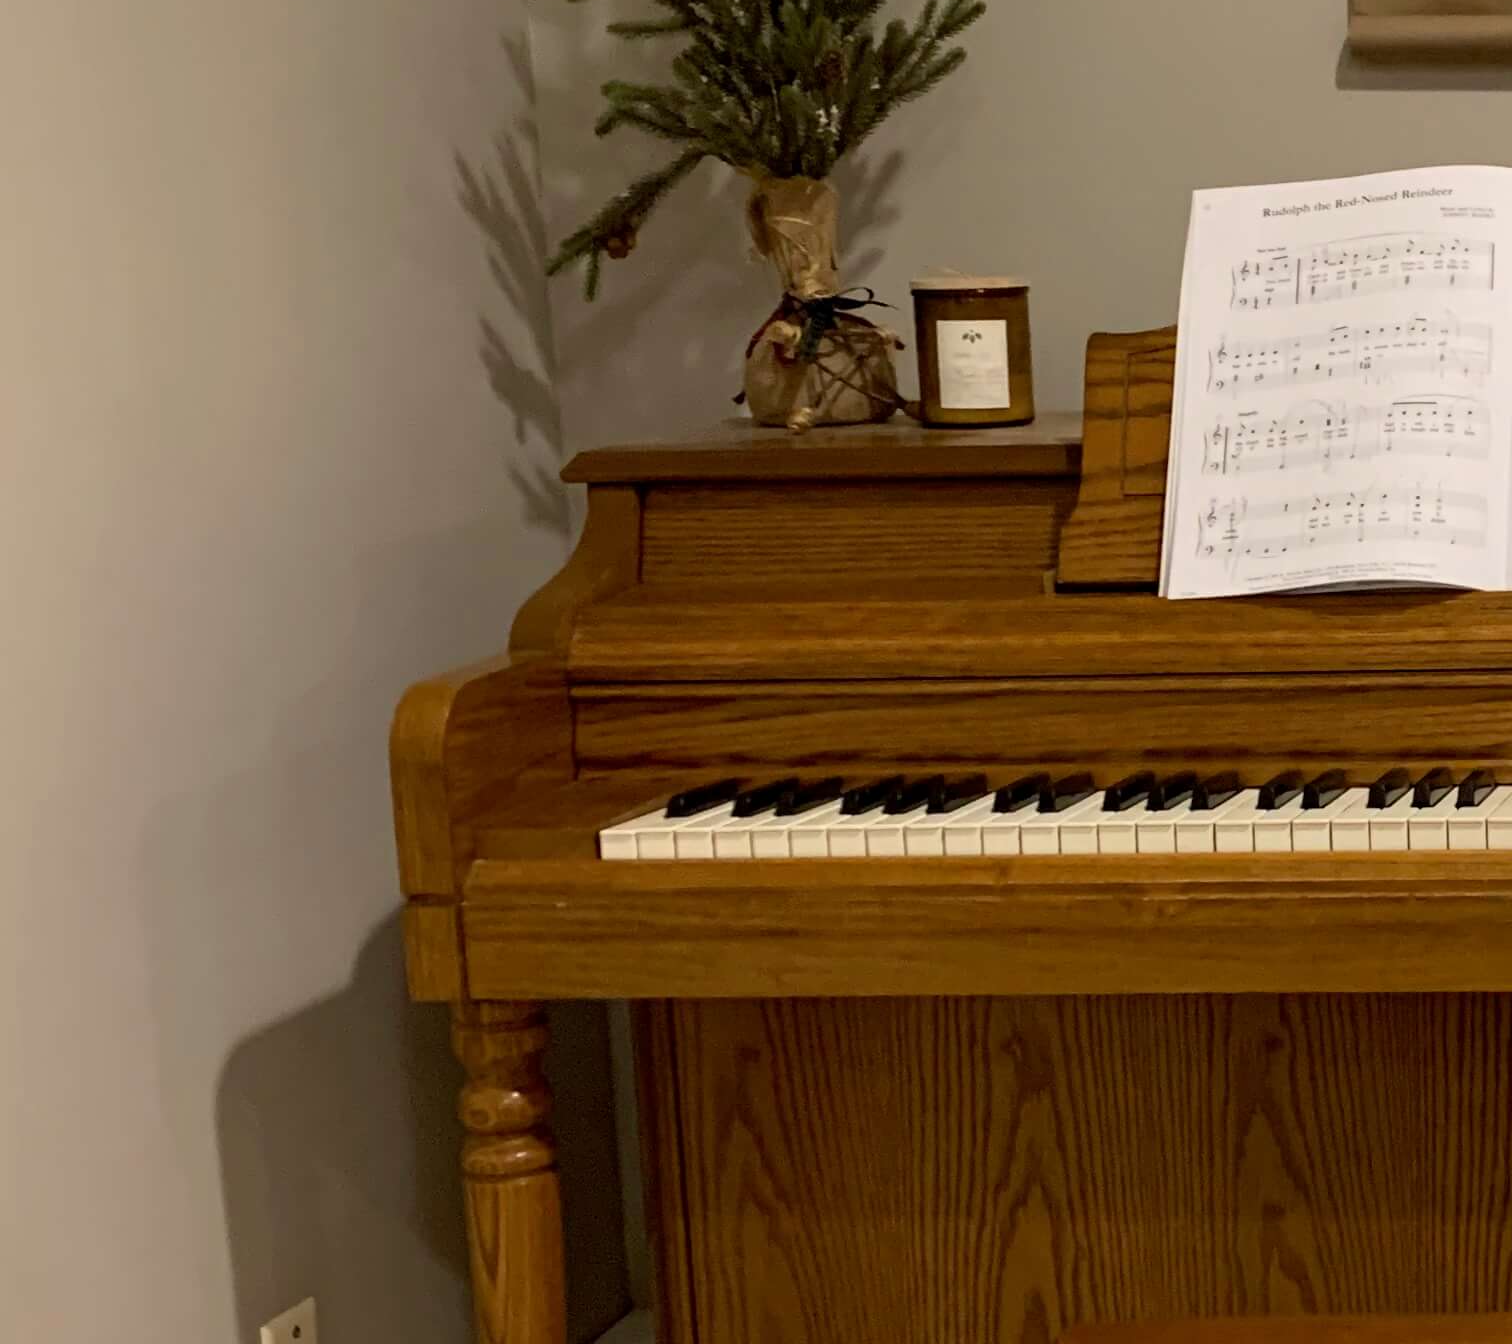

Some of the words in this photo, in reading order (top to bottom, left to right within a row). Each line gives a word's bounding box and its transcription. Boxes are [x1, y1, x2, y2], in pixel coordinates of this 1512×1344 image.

[1263, 203, 1311, 217] Rudolph
[1313, 200, 1332, 212] the
[1402, 186, 1453, 200] Reindeer
